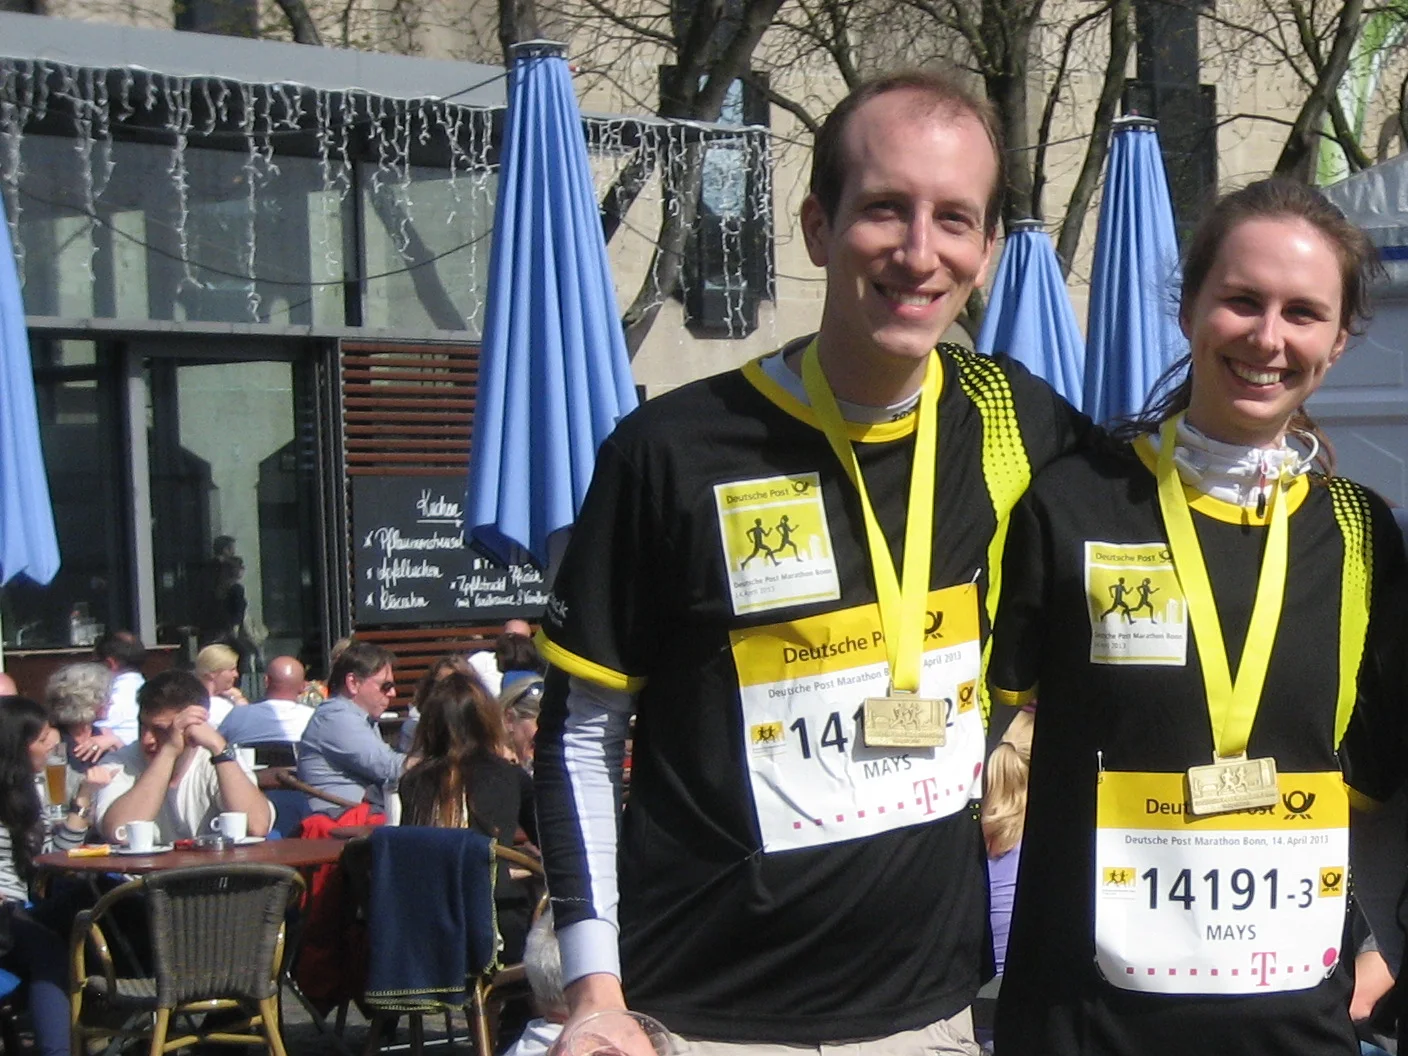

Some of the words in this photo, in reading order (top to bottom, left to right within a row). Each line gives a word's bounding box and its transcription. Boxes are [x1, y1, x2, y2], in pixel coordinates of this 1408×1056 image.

[726, 490, 768, 504] Deutsche
[770, 488, 789, 498] Post
[1095, 552, 1135, 562] Deutsche
[1137, 554, 1156, 562] Post
[765, 575, 780, 583] Post
[783, 636, 868, 664] Deutsche
[923, 656, 942, 668] April
[944, 651, 962, 662] 2013
[768, 684, 812, 699] Deutsche
[813, 679, 835, 691] Post
[836, 670, 882, 686] Marathon
[863, 754, 912, 780] MAYS
[1125, 835, 1168, 846] Deutsche
[1171, 836, 1192, 846] Post
[1194, 837, 1240, 846] Marathon
[1243, 836, 1268, 847] Bonn,
[1272, 837, 1286, 846] 14.
[1287, 836, 1308, 847] April
[1310, 834, 1329, 844] 2013
[1141, 867, 1314, 911] 14191-3
[1206, 924, 1257, 941] MAYS
